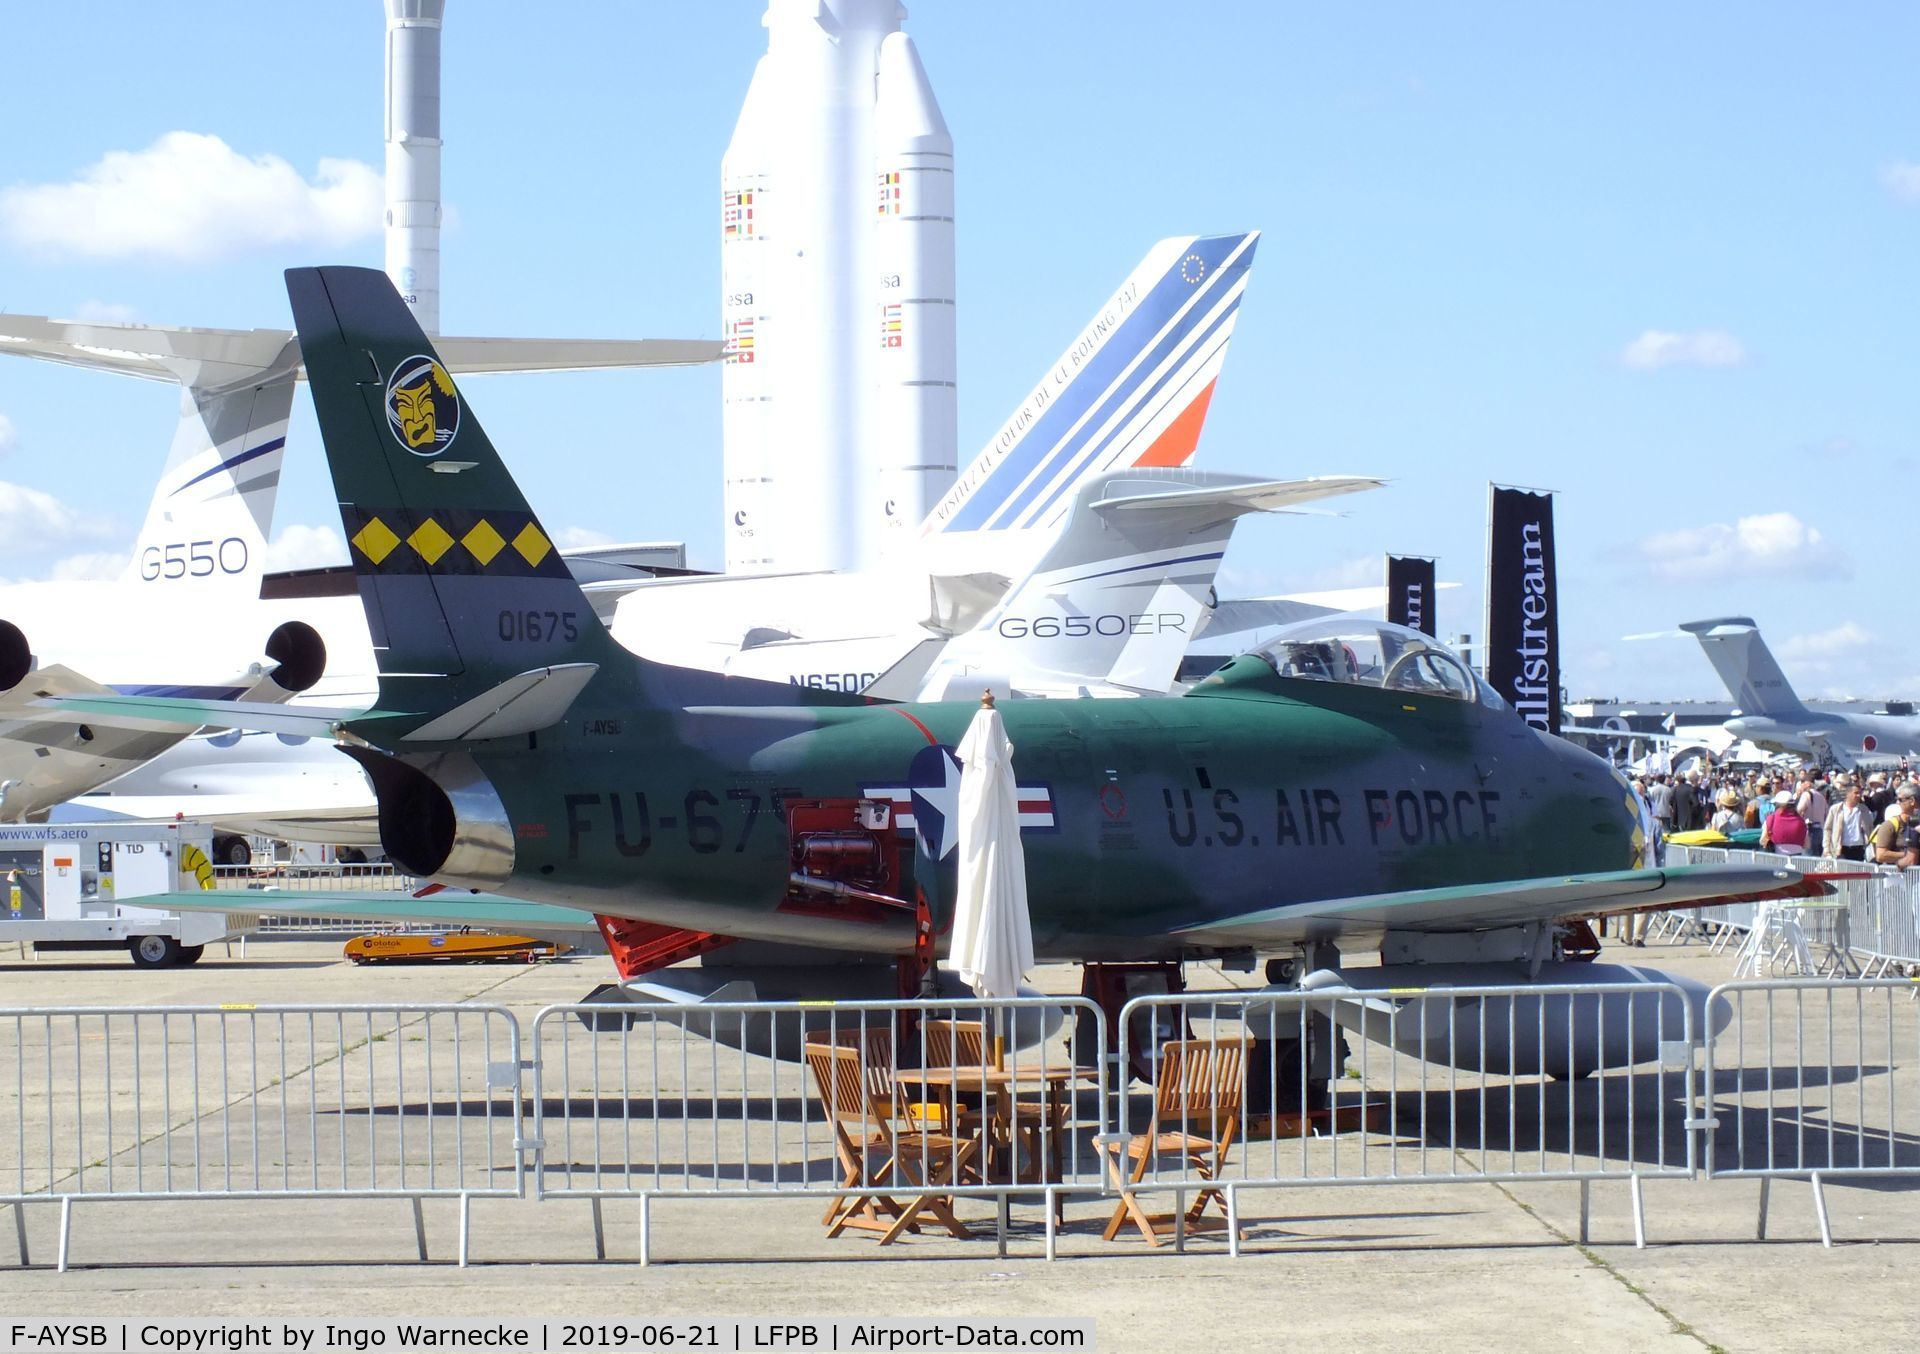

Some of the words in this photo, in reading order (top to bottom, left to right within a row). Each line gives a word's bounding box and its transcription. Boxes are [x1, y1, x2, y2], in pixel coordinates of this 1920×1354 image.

[880, 274, 901, 289] sa
[402, 295, 417, 304] sa
[728, 292, 754, 307] esa
[141, 537, 248, 581] G550
[498, 610, 578, 642] 01675
[999, 613, 1187, 638] G650ER
[789, 672, 881, 694] N650G
[1162, 789, 1260, 847] U.S.
[1276, 789, 1345, 846] AIR
[1364, 789, 1500, 846] FORCE
[0, 828, 88, 840] www.wfs.aero
[126, 844, 144, 853] TLD
